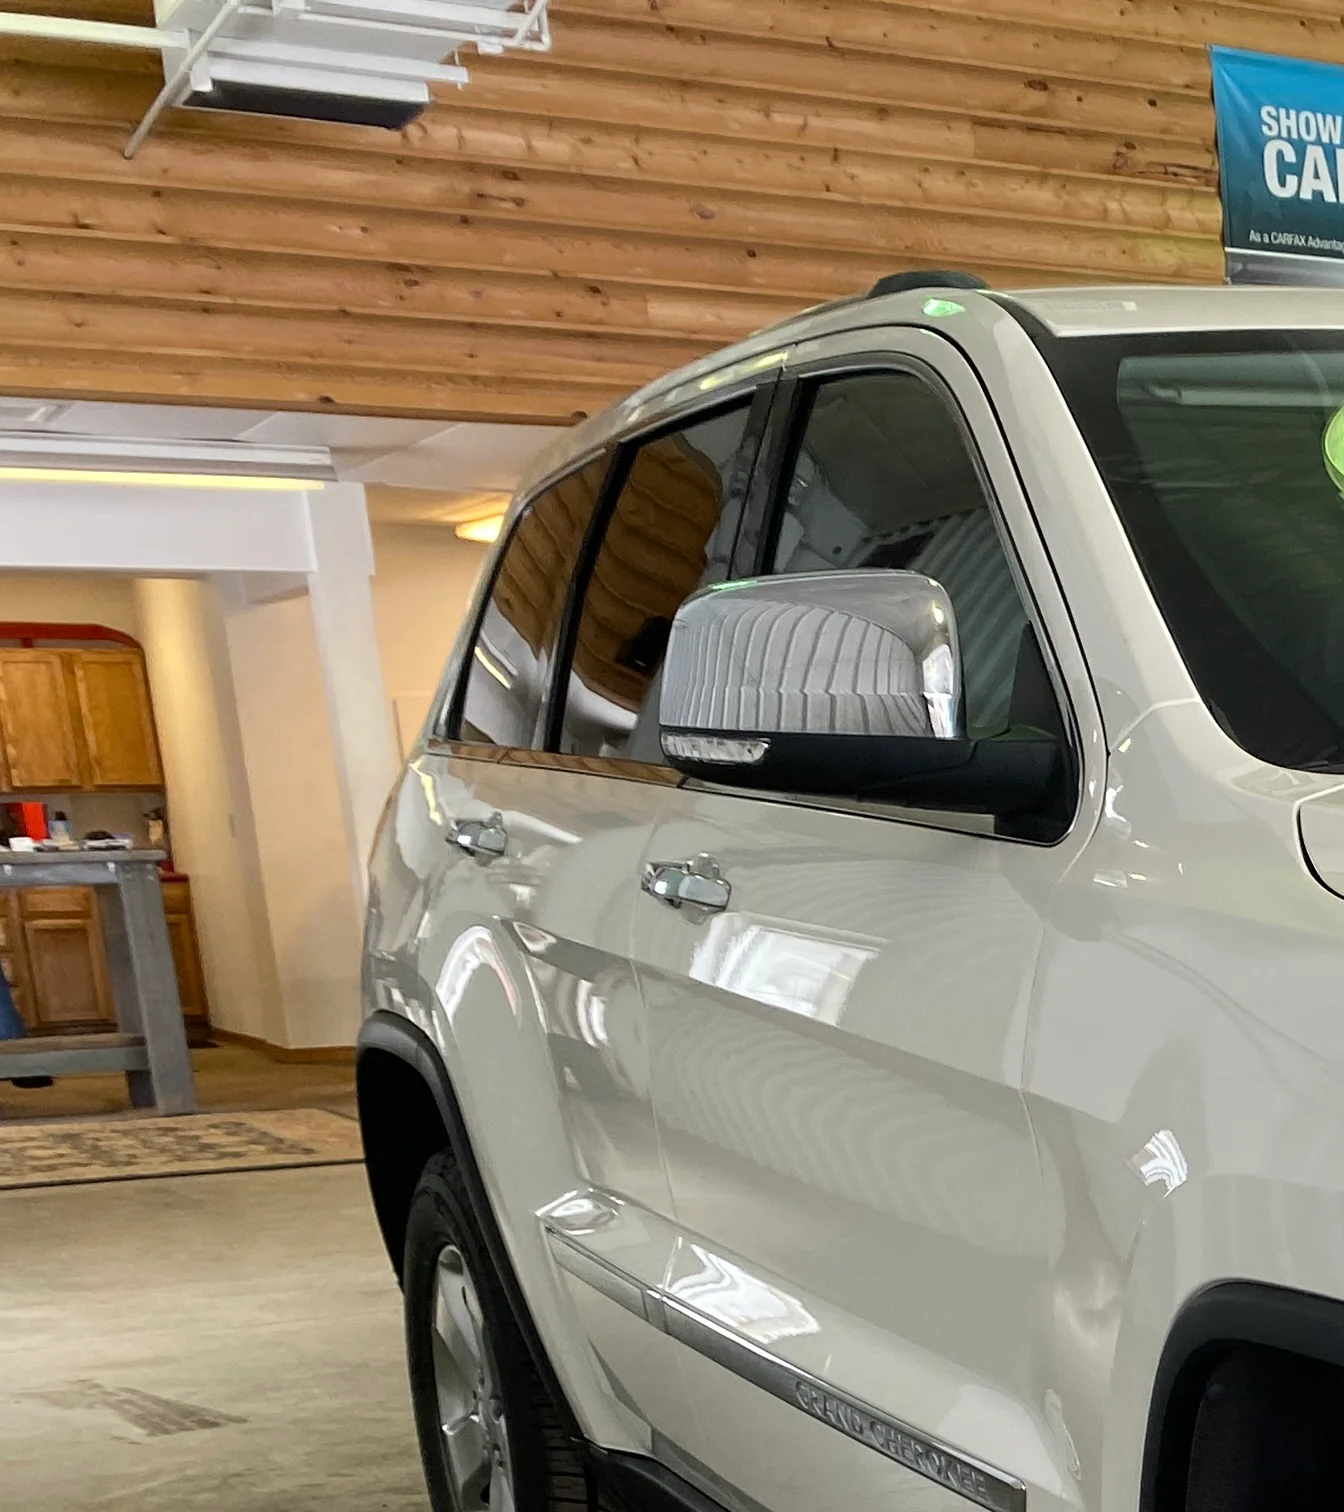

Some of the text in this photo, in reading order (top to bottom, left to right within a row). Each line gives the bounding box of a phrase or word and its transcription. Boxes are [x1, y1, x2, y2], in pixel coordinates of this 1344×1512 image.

[1260, 105, 1342, 146] SHOW
[1249, 229, 1262, 242] As
[1263, 233, 1270, 243] a
[1270, 231, 1306, 247] CARFAX
